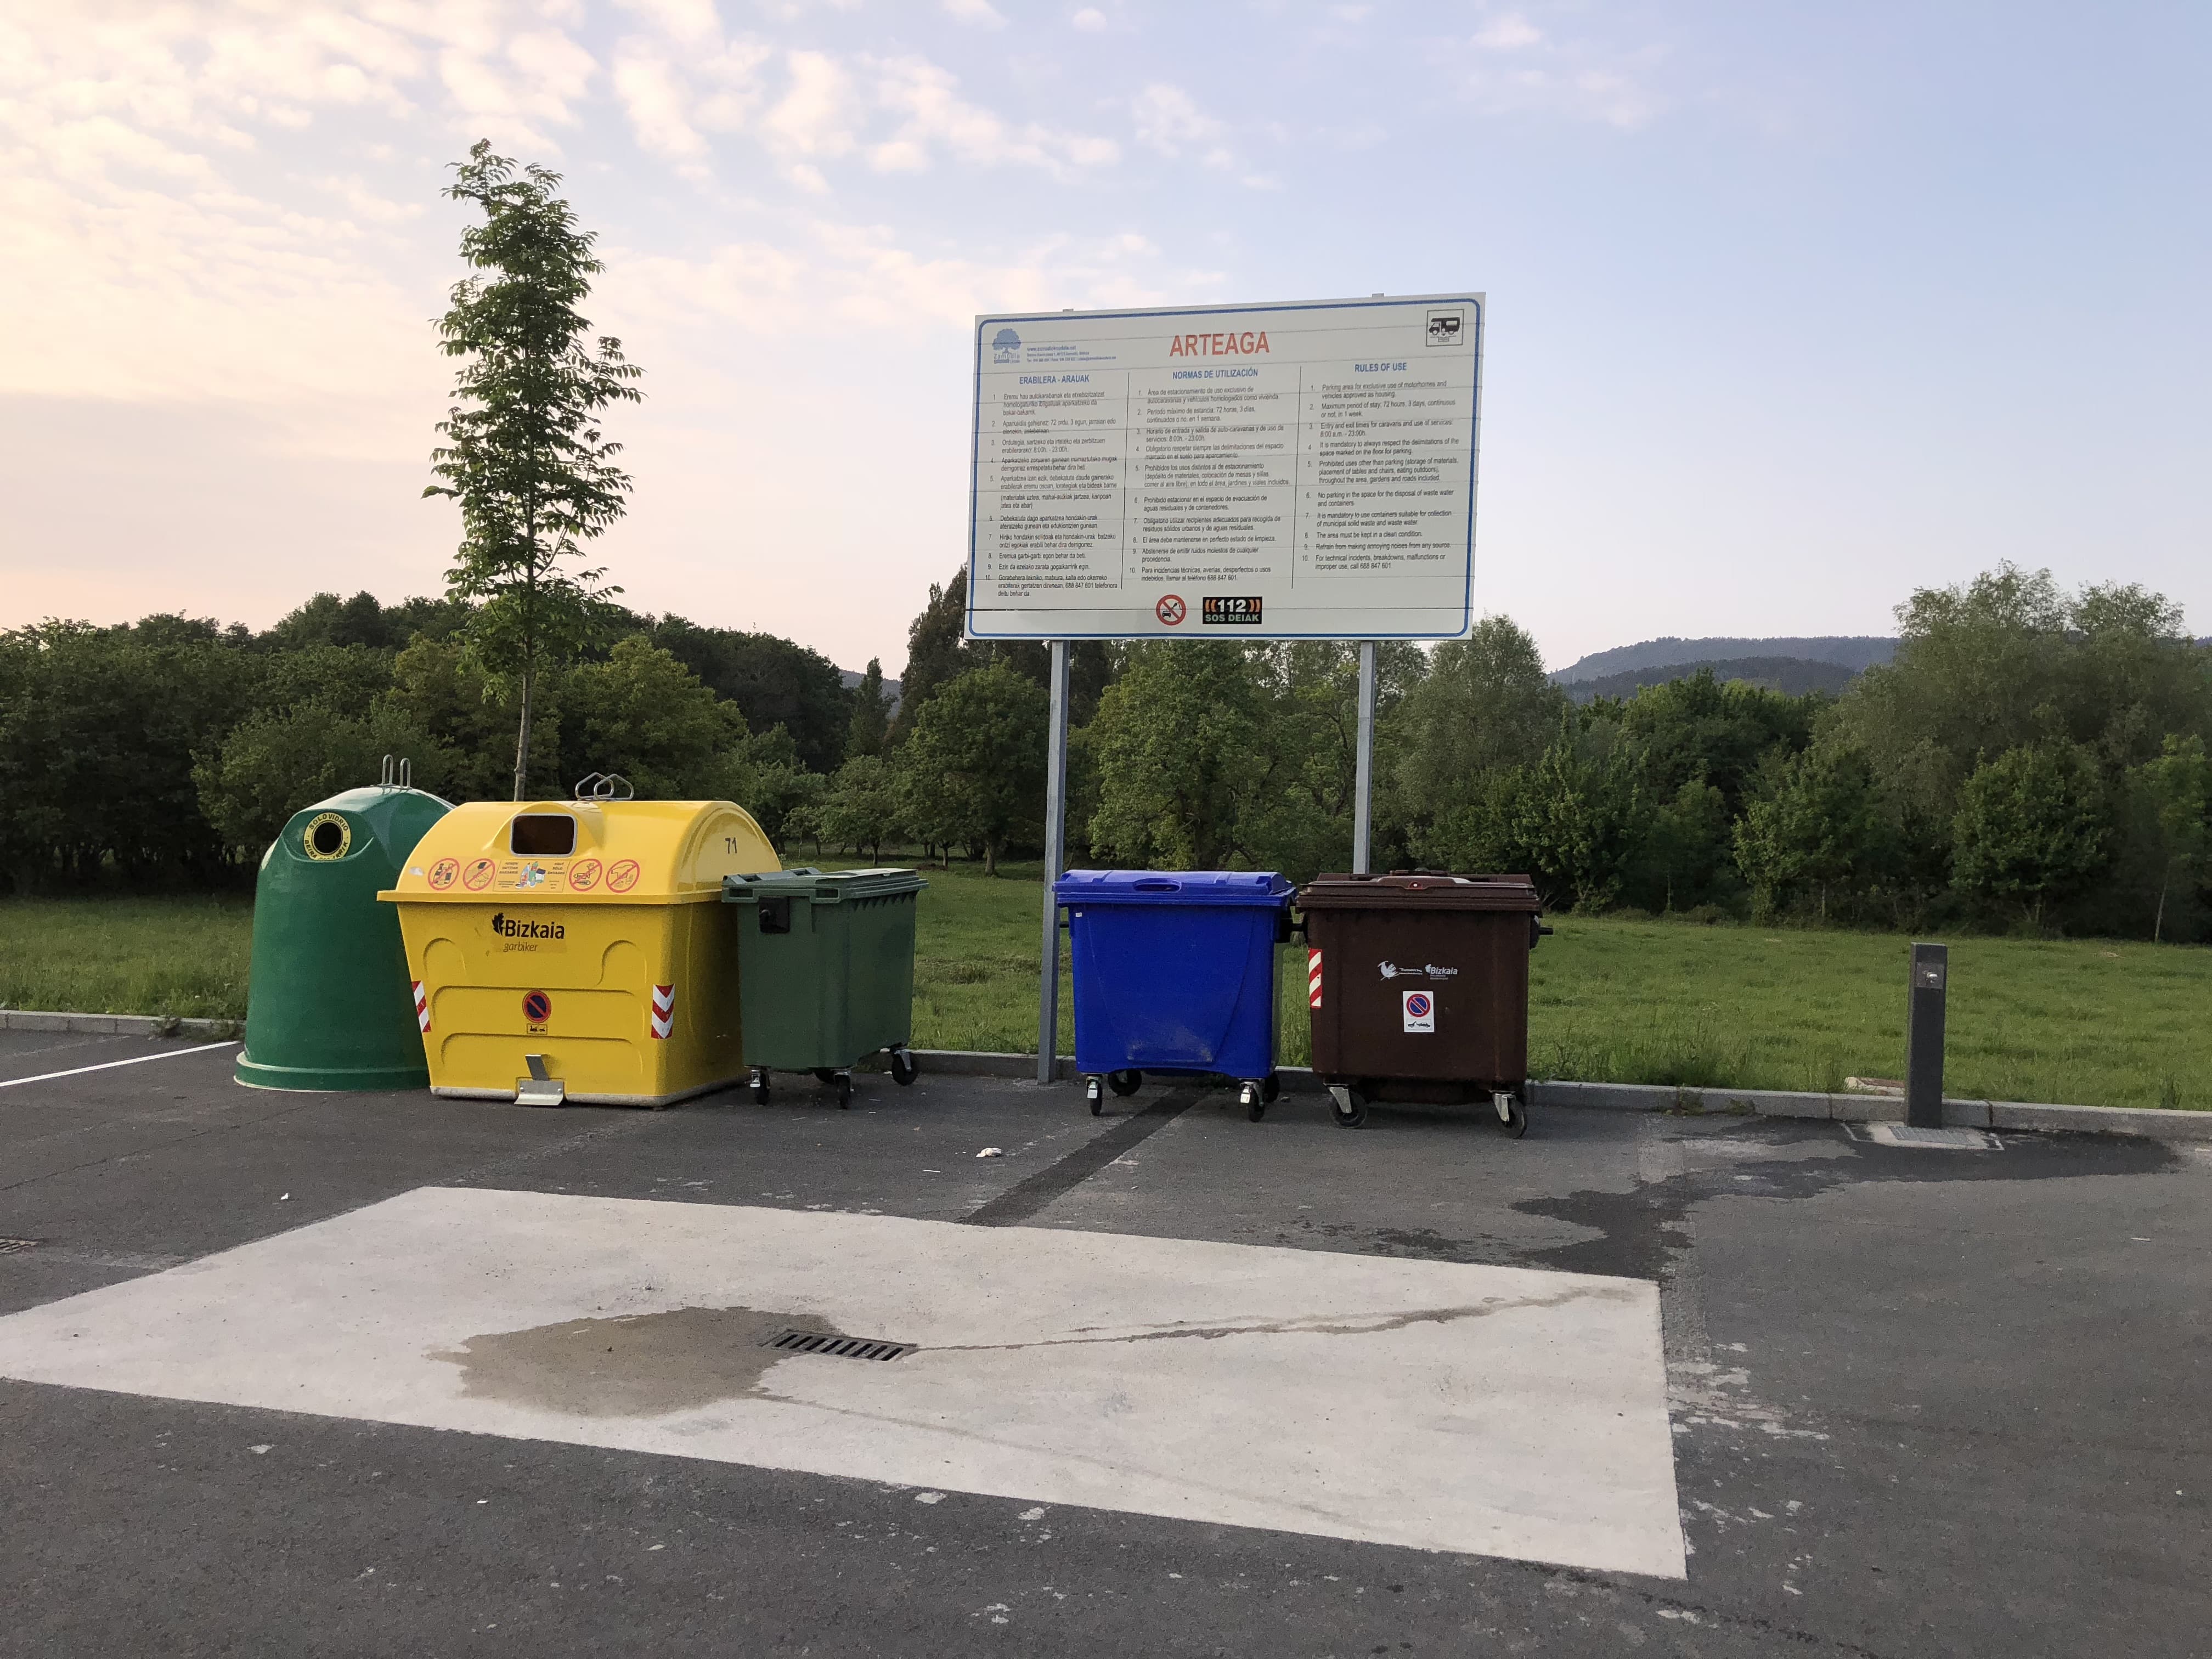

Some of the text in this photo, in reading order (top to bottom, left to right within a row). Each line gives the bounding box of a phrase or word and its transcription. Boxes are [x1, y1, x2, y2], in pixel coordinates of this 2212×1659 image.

[1169, 331, 1269, 357] ARTEAGA
[1172, 367, 1258, 379] NORMAS DE UTILIZACIÓN
[1355, 363, 1407, 372] RULES OF USE
[1019, 376, 1056, 385] ERABILERA
[1062, 375, 1090, 383] ARAUAK
[1217, 599, 1246, 612] 112
[1205, 614, 1259, 622] SOS DEIAK
[309, 813, 348, 831] SOLO VIDRIO
[725, 837, 737, 854] 71
[505, 919, 565, 939] Bizkaia
[503, 941, 538, 952] garbiker
[1430, 967, 1458, 975] Bizkaia
